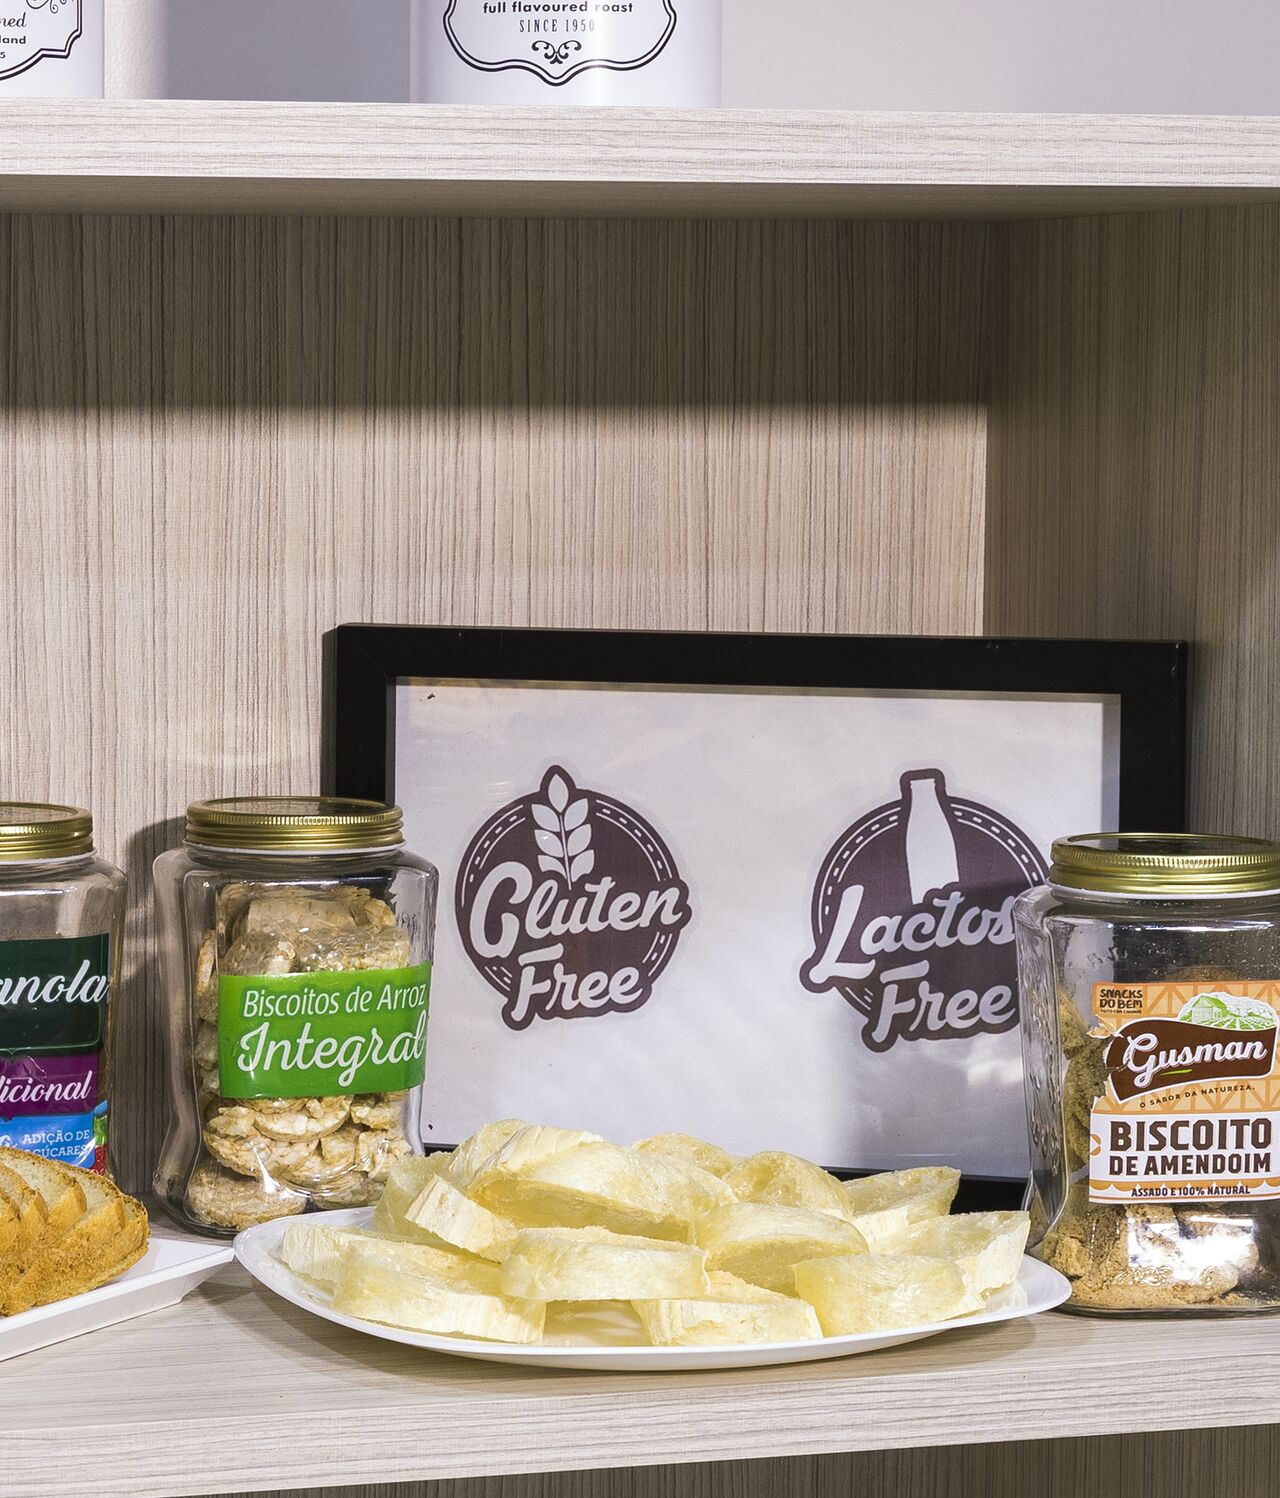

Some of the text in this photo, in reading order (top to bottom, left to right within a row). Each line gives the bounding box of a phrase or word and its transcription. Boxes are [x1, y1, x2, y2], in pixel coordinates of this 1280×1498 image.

[483, 1, 633, 14] full flavoured roast
[519, 19, 595, 33] SINCE 1950
[469, 861, 683, 960] Gluten
[809, 885, 1016, 985] Lactos
[513, 943, 645, 1020] Free
[1100, 988, 1143, 999] SNACKS
[242, 984, 426, 1018] Biscoitos de Arroz
[872, 960, 1016, 1044] Free
[1100, 999, 1143, 1009] DO BEM
[237, 1009, 427, 1086] Integral
[1126, 1032, 1267, 1088] Gusman
[1150, 1094, 1181, 1106] SABOR
[22, 1129, 74, 1146] ADIÇÃO
[76, 1129, 90, 1141] DE
[1109, 1117, 1272, 1152] BISCOITO
[1109, 1152, 1271, 1176] DE AMENDOIM
[1131, 1185, 1251, 1197] ASSADO E 100% NATURAL
